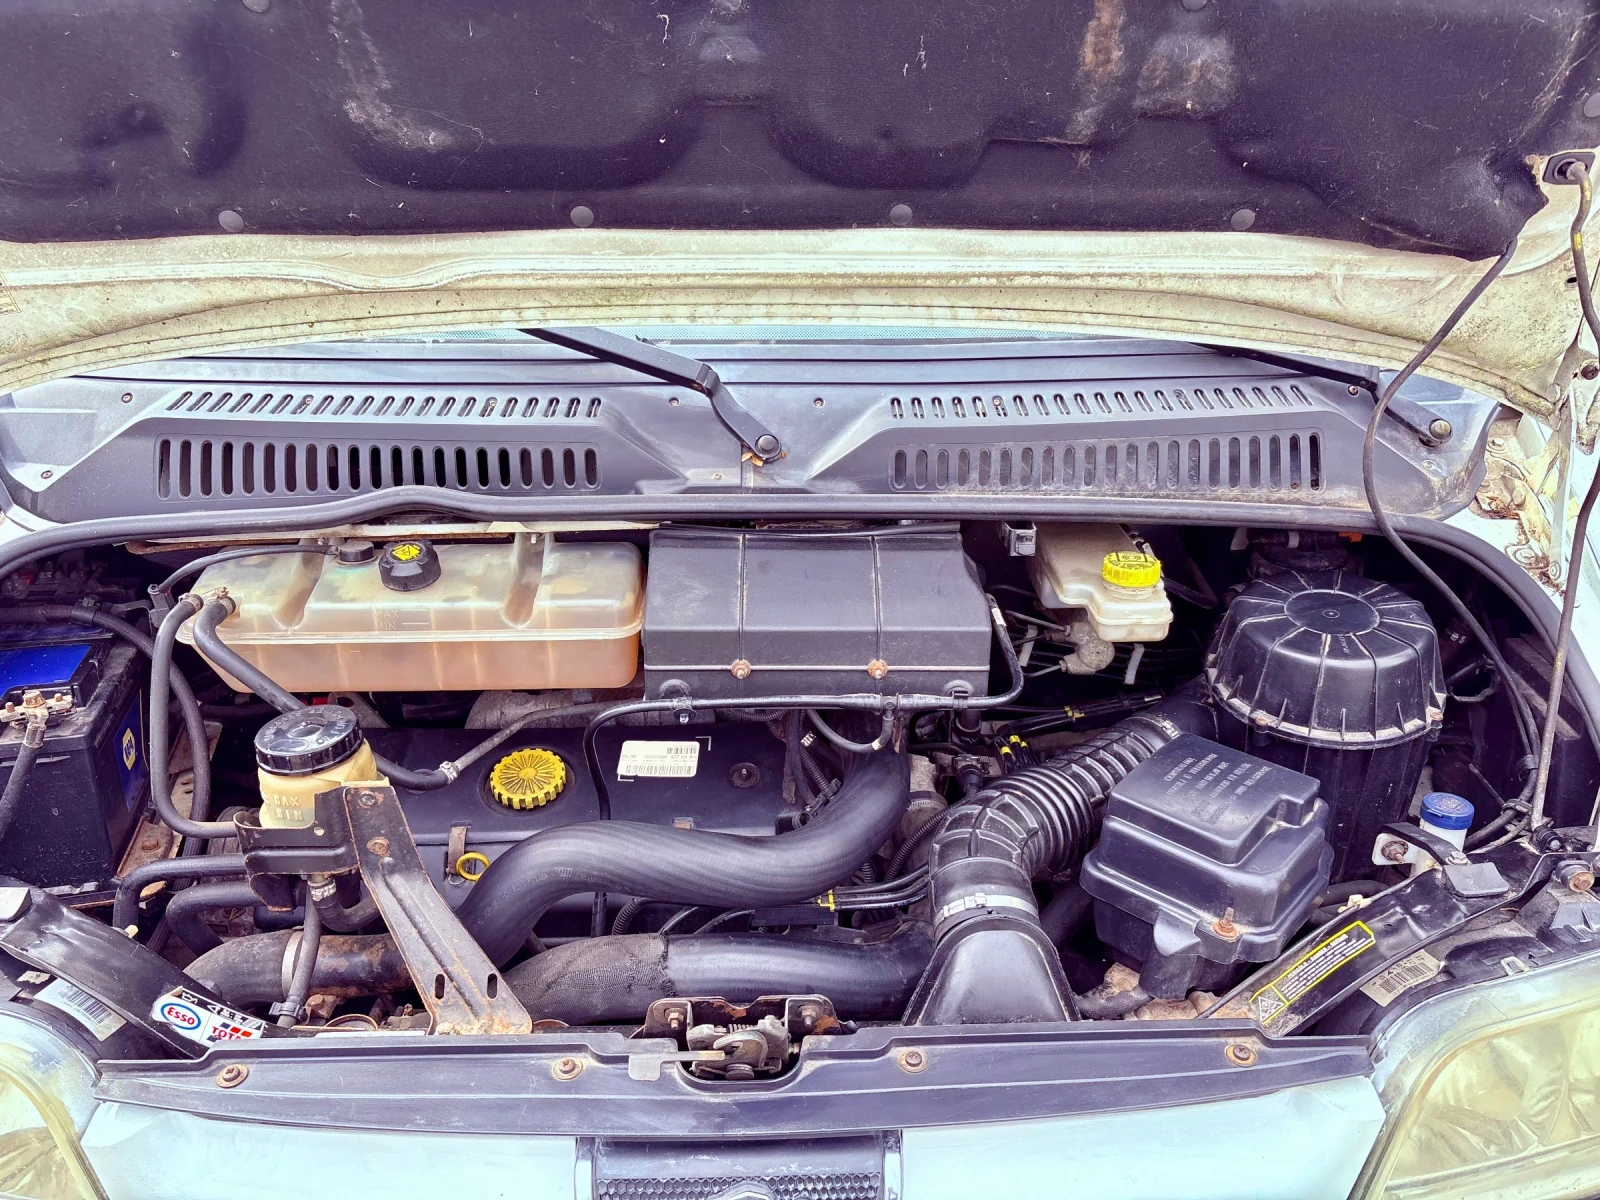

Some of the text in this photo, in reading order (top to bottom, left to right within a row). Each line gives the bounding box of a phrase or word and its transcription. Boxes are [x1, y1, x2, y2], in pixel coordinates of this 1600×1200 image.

[375, 609, 398, 618] MAX
[375, 621, 396, 630] MIN
[273, 794, 299, 806] MAX
[167, 1006, 195, 1025] ESSO
